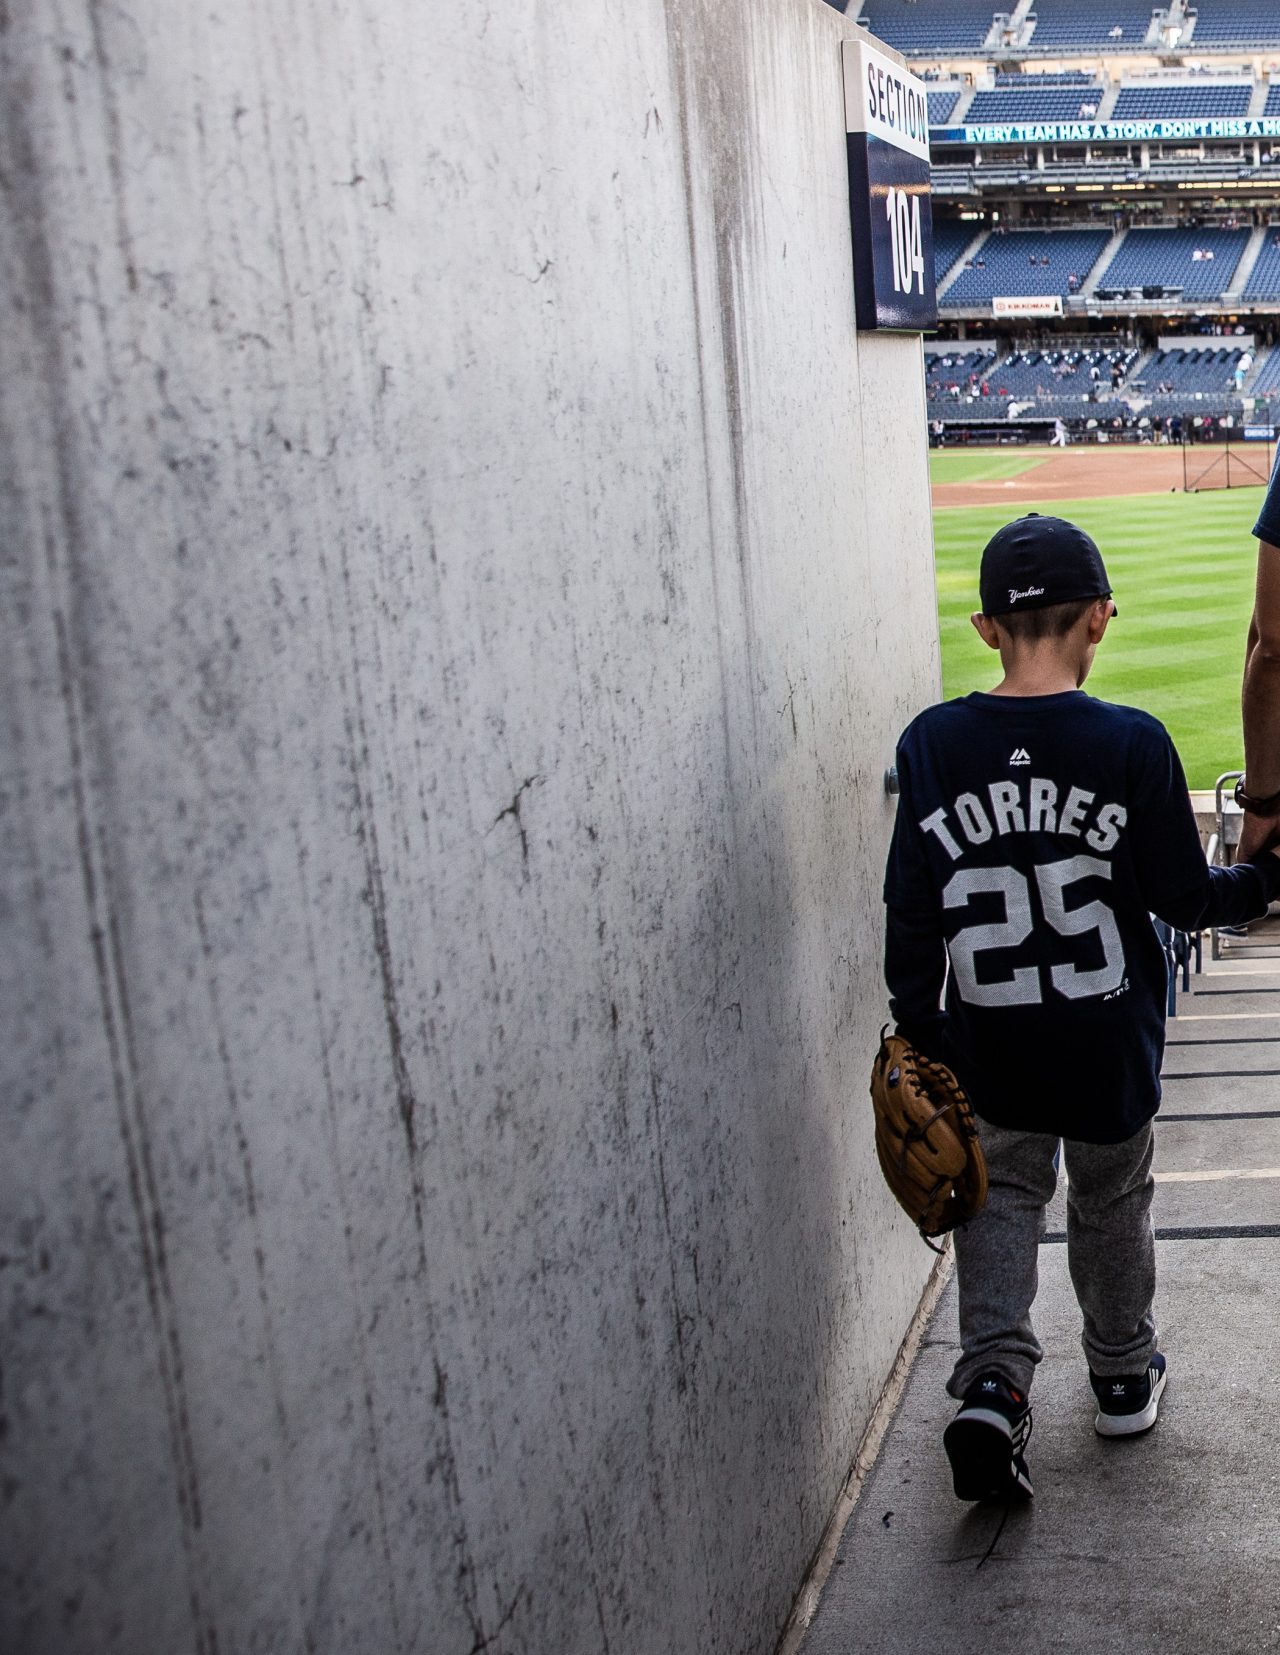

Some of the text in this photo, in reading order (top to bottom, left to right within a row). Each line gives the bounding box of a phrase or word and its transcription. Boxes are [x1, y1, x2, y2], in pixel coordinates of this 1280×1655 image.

[868, 62, 927, 144] SECTION
[965, 126, 1012, 142] EVERY
[1016, 125, 1058, 141] TEAM
[1060, 124, 1091, 140] HAS
[1093, 124, 1105, 139] A
[1106, 122, 1159, 139] STORY.
[1161, 121, 1208, 138] DON'T
[1211, 120, 1247, 136] MISS
[1248, 119, 1261, 136] A
[886, 186, 924, 295] 104
[1008, 586, 1045, 603] Yankees
[919, 777, 1128, 861] TORRES
[942, 854, 1126, 1007] 25
